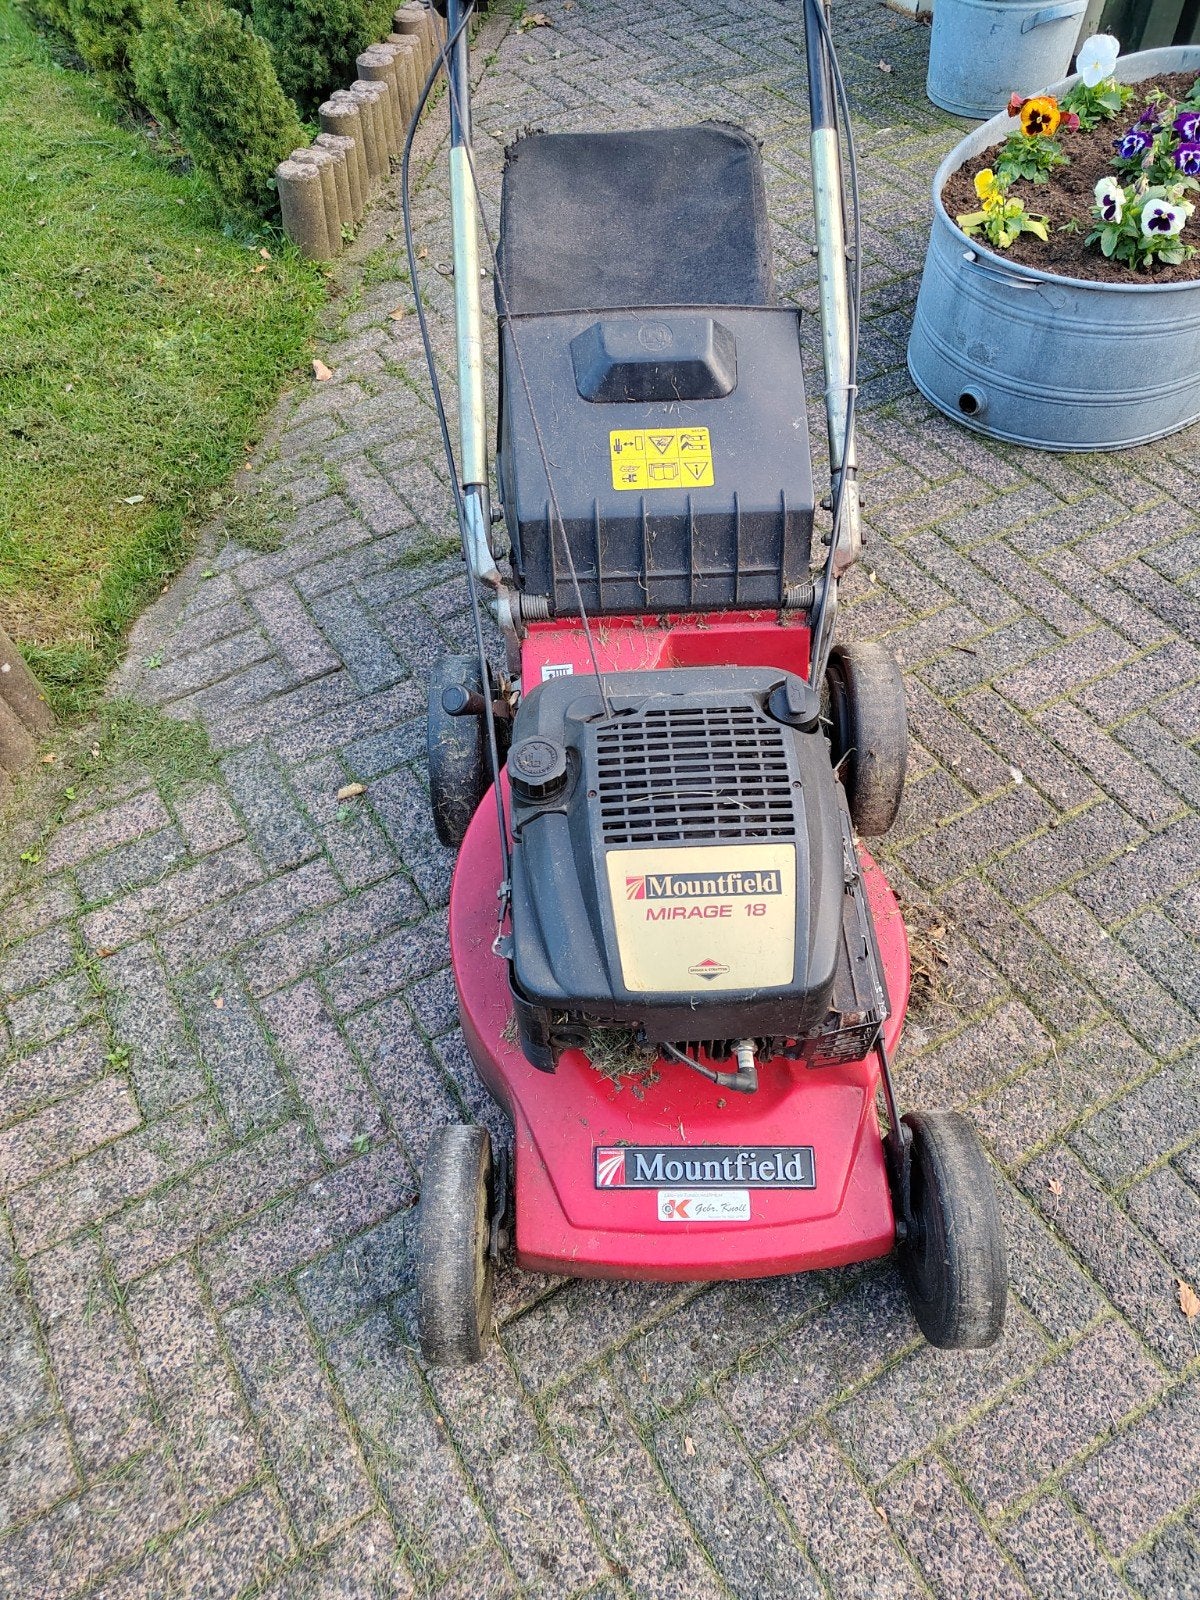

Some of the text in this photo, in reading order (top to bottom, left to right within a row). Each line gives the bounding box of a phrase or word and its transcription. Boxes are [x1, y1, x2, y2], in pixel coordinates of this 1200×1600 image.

[648, 871, 778, 897] Mountfield
[646, 903, 767, 921] MIRAGE 18
[633, 1152, 804, 1182] Mountfield
[695, 1202, 747, 1215] Gebr. Knoll
